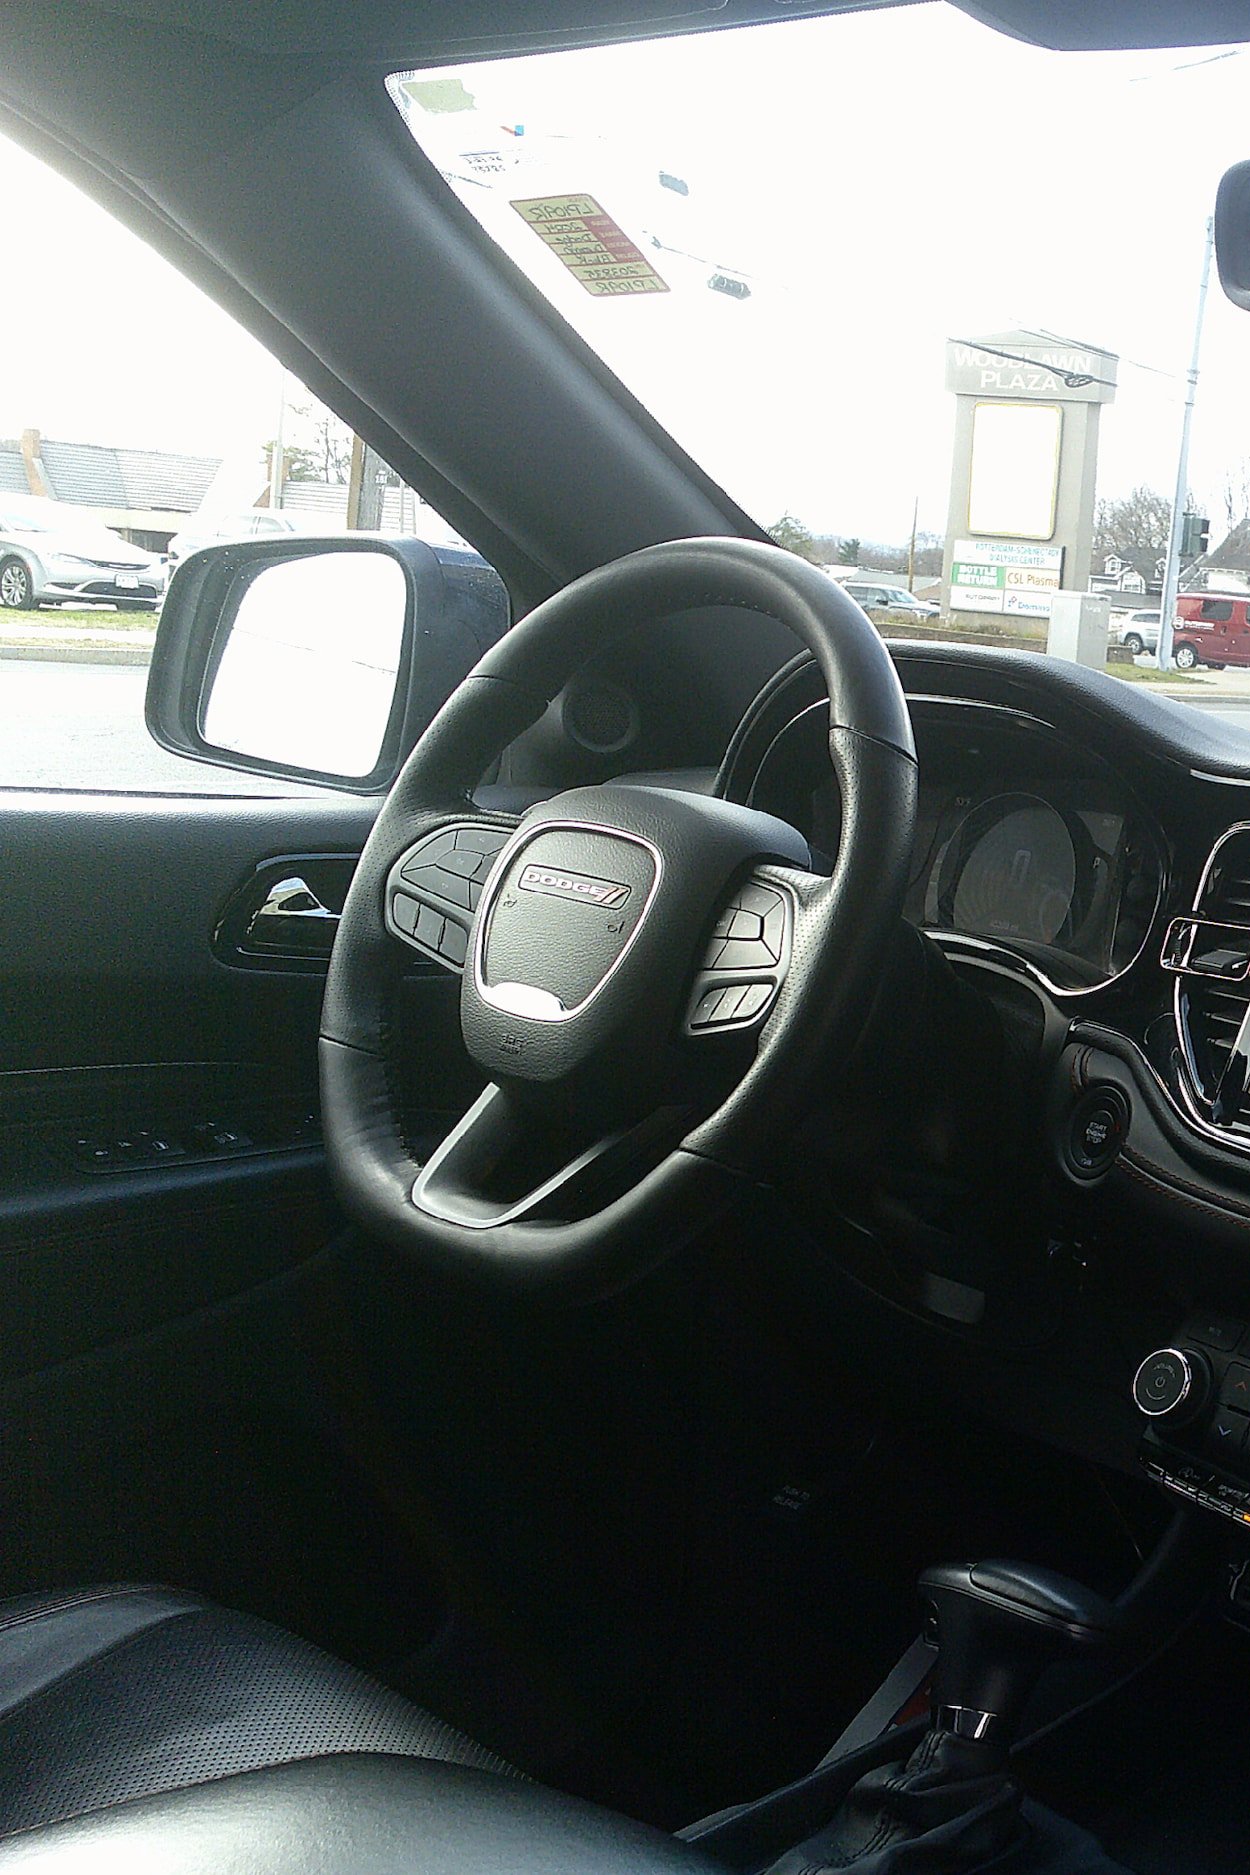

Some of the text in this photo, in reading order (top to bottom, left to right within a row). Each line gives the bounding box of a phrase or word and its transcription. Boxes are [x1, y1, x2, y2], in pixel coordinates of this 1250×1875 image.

[980, 370, 1059, 391] PLAZA
[1007, 572, 1059, 587] CSL Plasma
[527, 871, 607, 897] DODGE
